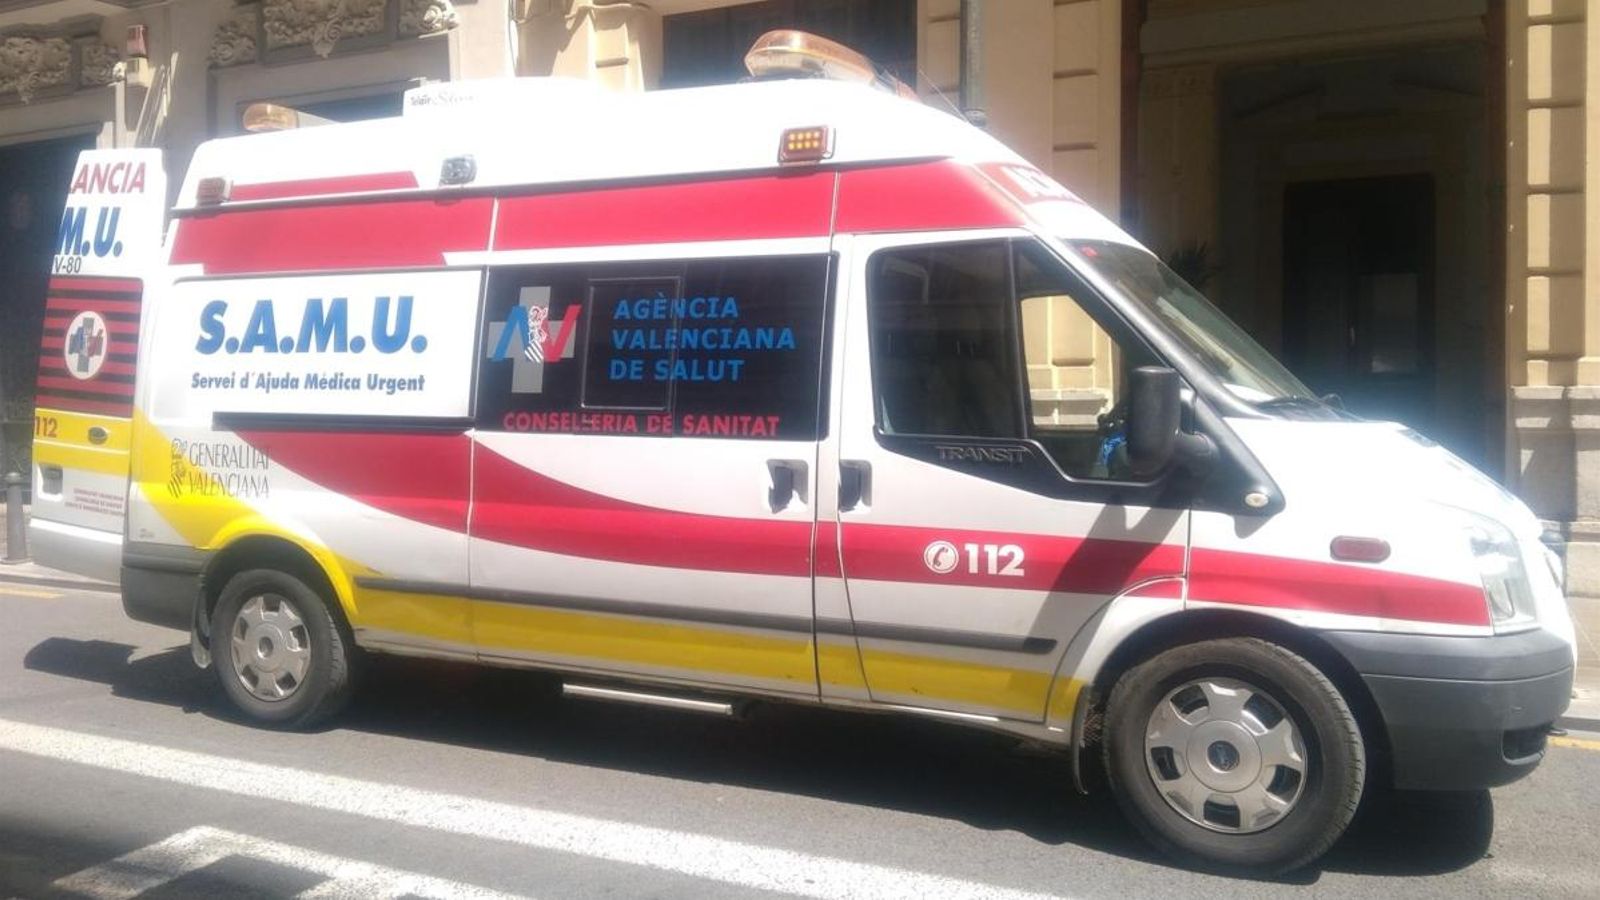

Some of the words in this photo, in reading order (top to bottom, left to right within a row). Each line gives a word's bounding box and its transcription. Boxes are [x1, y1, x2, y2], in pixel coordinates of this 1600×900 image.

[69, 161, 146, 194] ANCIA
[613, 292, 739, 320] AGÈNCIA
[195, 296, 428, 354] S.A.M.U.
[611, 327, 796, 350] VALENCIANA
[191, 372, 235, 389] Servei
[304, 372, 361, 390] Médica
[367, 373, 425, 395] Urgent
[609, 359, 645, 380] DE
[654, 359, 745, 381] SALUT
[647, 414, 672, 433] DE
[682, 414, 780, 437] SANITAT
[189, 442, 270, 470] GENERALITAT
[936, 445, 1030, 464] TRANSIT
[189, 472, 270, 499] VALENCIANA
[964, 543, 1025, 577] 112
